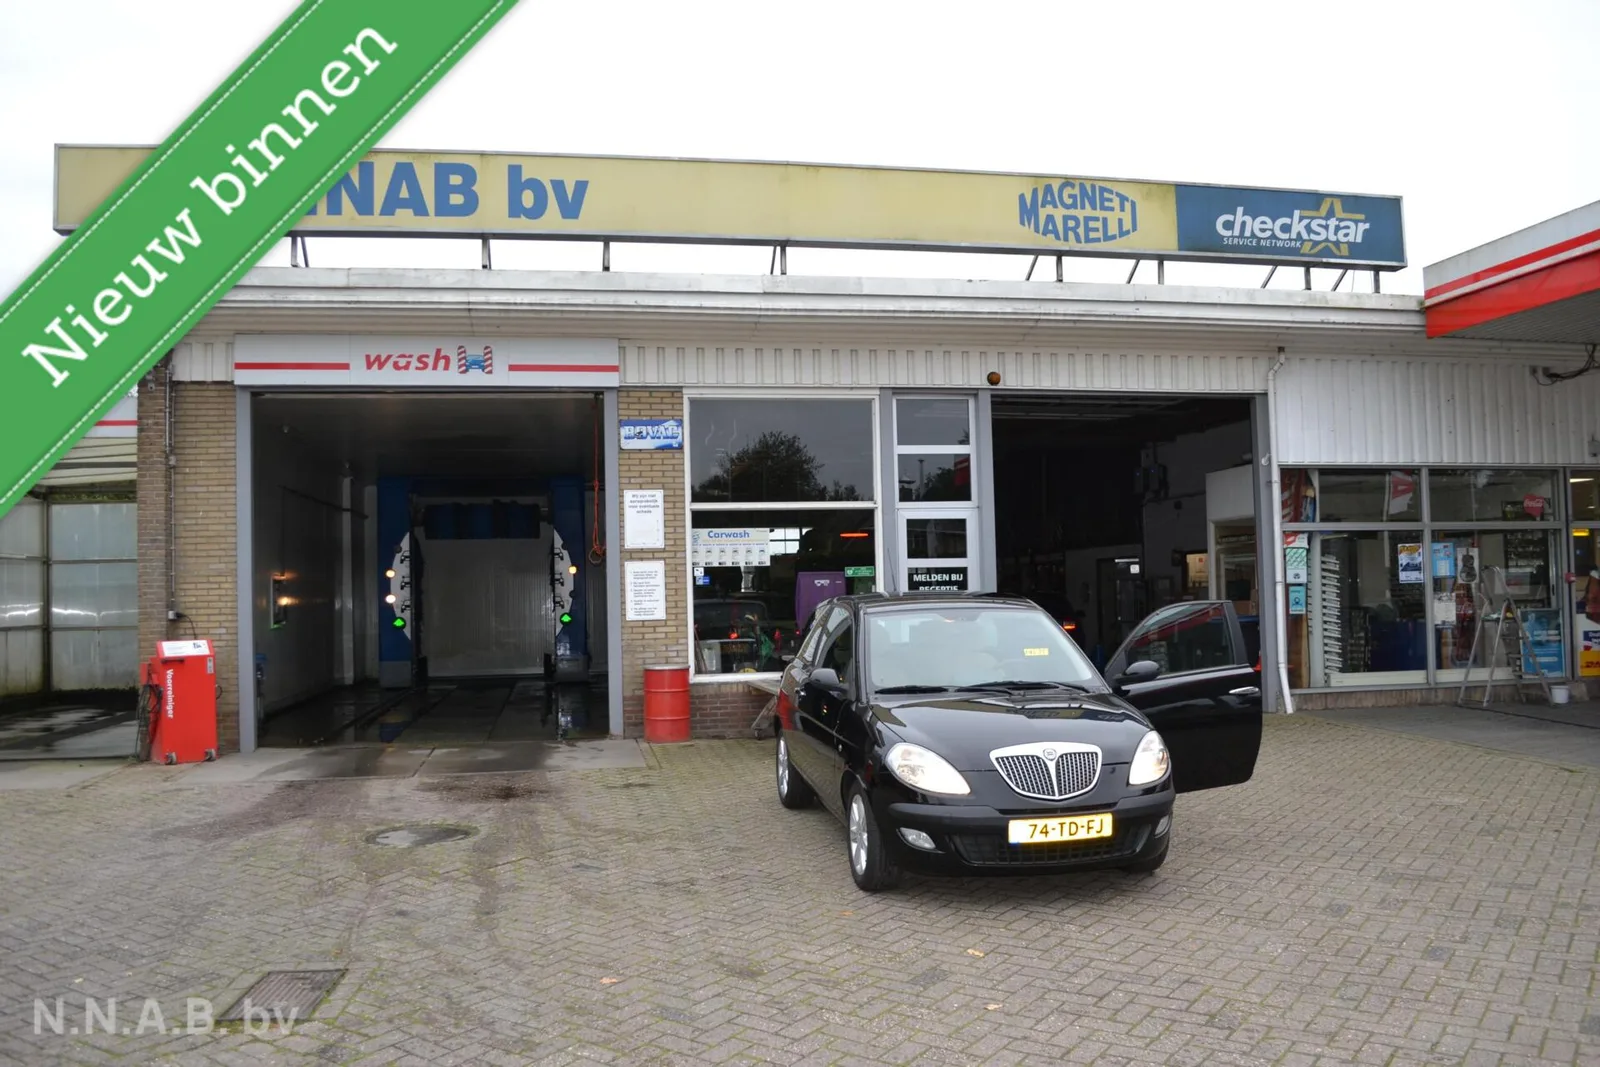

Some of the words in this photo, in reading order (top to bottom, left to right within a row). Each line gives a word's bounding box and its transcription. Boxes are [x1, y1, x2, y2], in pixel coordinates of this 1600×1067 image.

[306, 161, 479, 217] NAB
[507, 164, 589, 220] bv
[1018, 181, 1137, 222] MAGNETI
[1018, 203, 1137, 244] MARELLI
[1215, 206, 1370, 243] checkstar
[1223, 237, 1257, 246] SERVICE
[1259, 239, 1301, 248] NETWORK
[364, 347, 451, 372] wash
[707, 530, 750, 539] Carwash
[913, 573, 950, 582] MELDEN
[951, 573, 963, 581] BIJ
[166, 668, 175, 719] Voorreiniger
[1028, 818, 1104, 839] 74-TD-FJ
